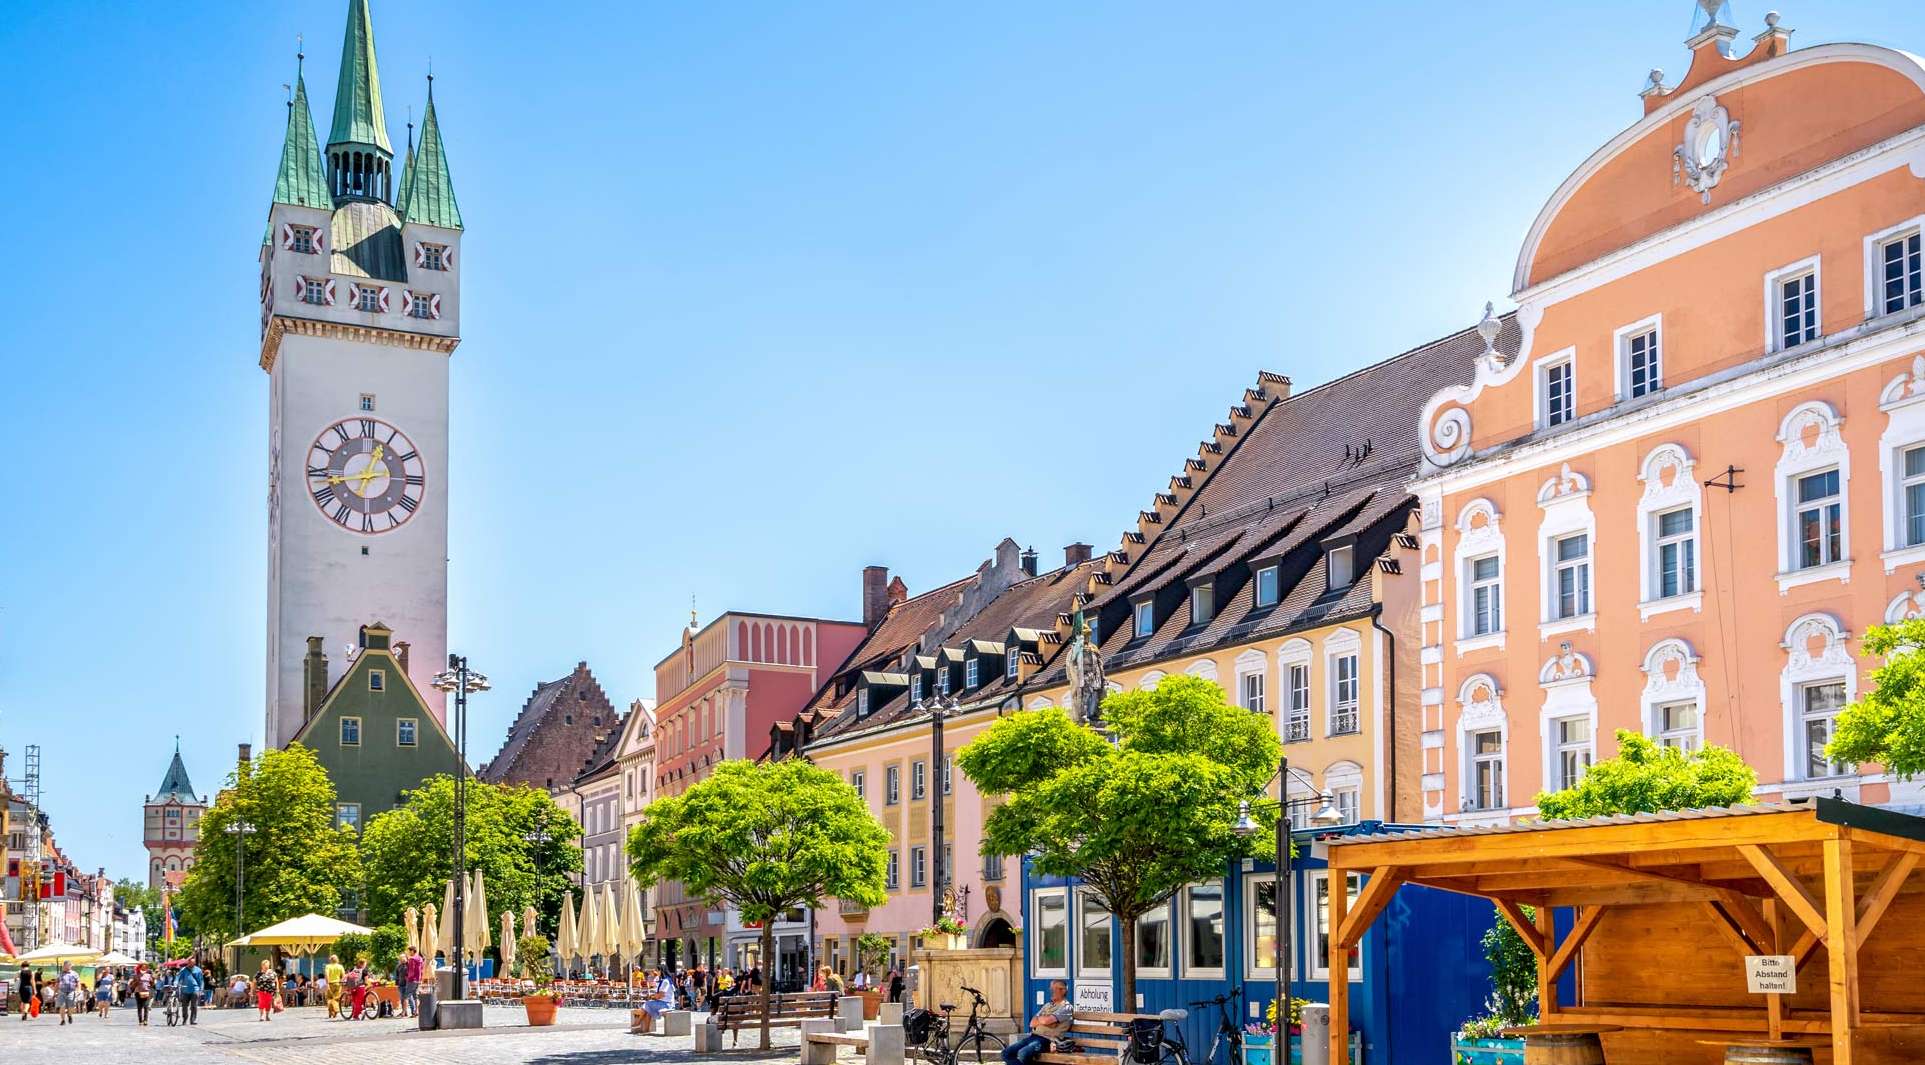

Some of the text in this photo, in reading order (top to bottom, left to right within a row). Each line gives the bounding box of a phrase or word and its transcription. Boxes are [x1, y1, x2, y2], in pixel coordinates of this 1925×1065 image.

[333, 423, 350, 442] XI
[360, 419, 376, 439] XII
[400, 451, 418, 462] II
[405, 475, 424, 485] III
[361, 513, 374, 532] VI
[387, 510, 400, 528] V
[1761, 958, 1780, 967] Bitte
[1755, 970, 1788, 978] Abstand
[1759, 981, 1786, 990] halten!
[1080, 988, 1109, 1002] Abholung
